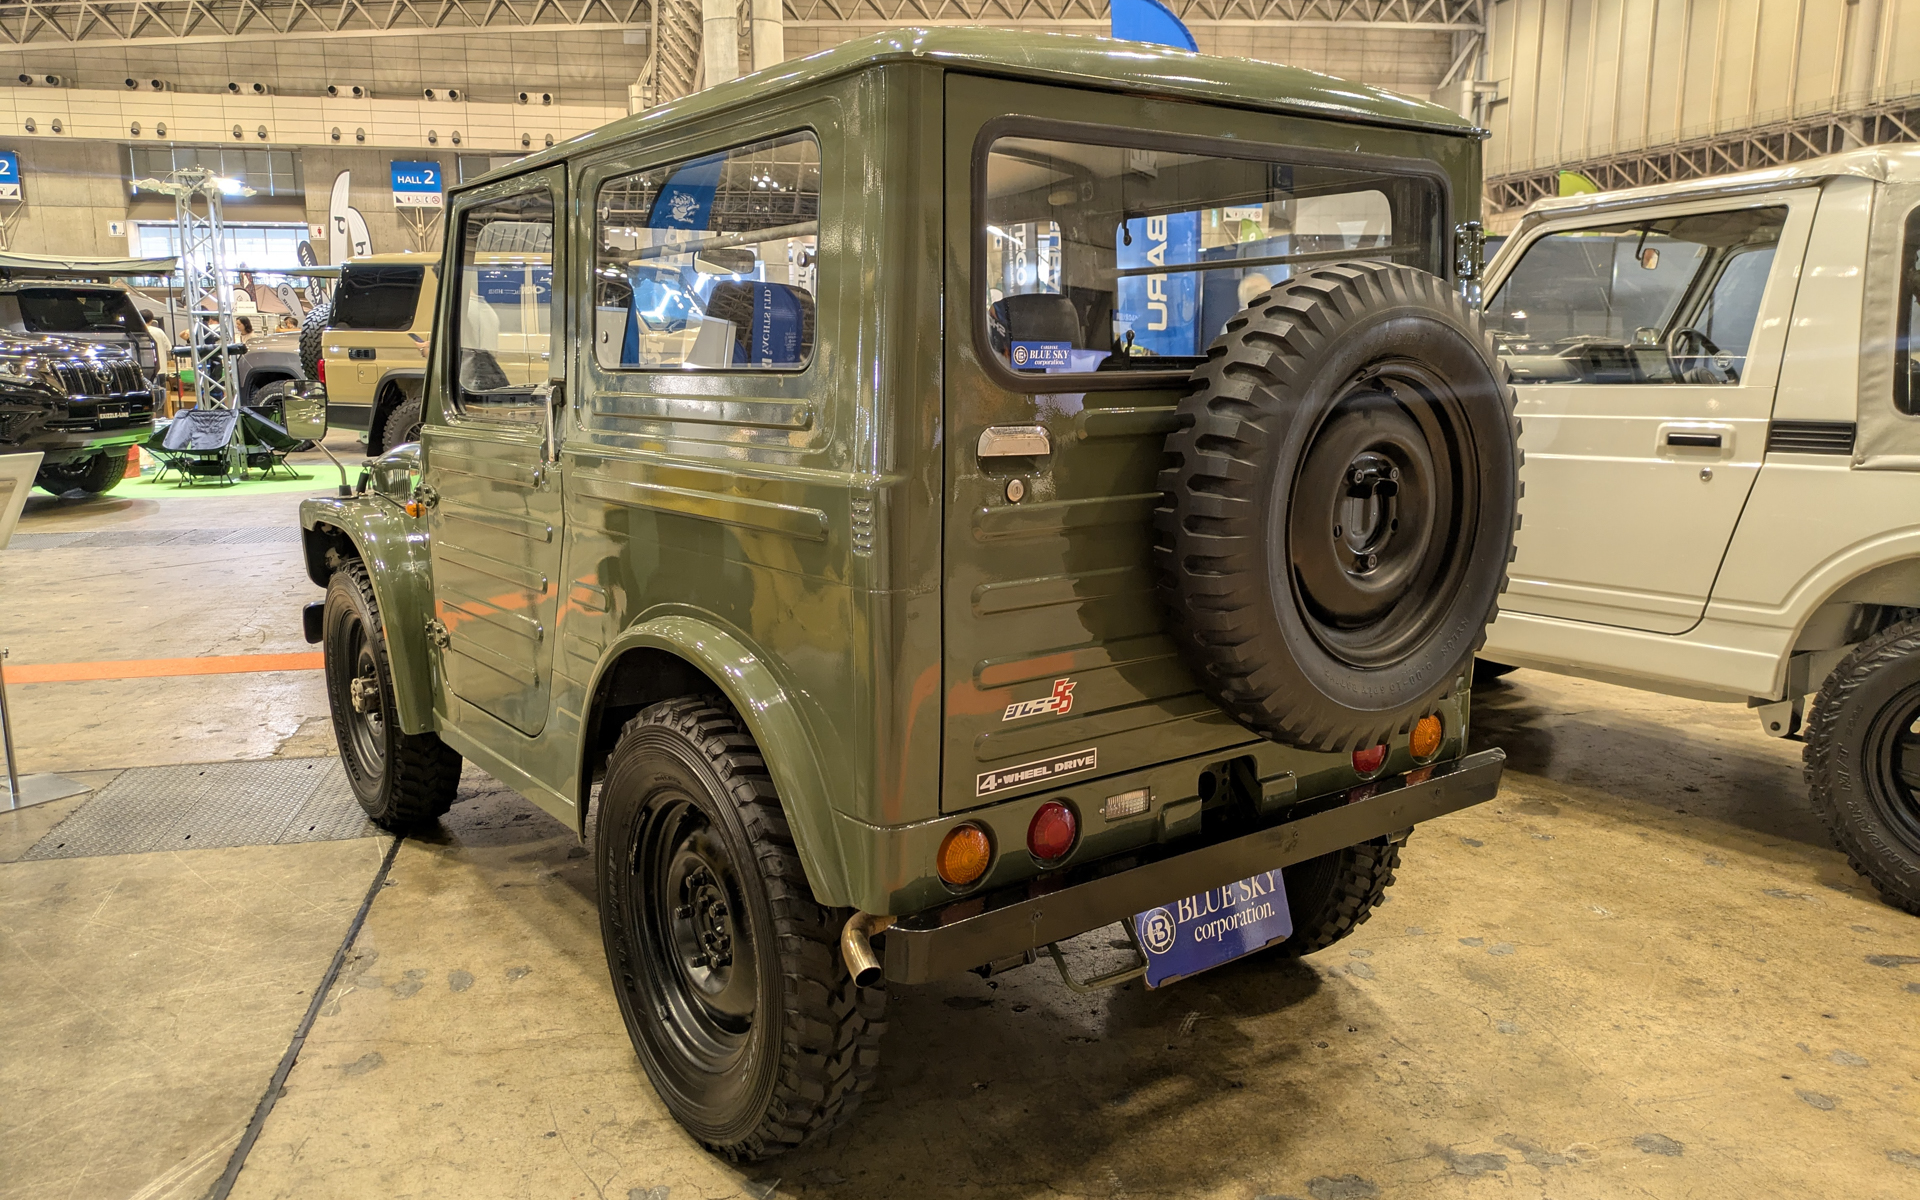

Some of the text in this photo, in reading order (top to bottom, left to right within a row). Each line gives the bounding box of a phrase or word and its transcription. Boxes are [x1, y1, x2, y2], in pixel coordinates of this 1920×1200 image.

[0, 159, 10, 175] 2
[397, 169, 435, 185] HALL 2
[1029, 350, 1069, 360] BLUE SKY
[1054, 755, 1095, 773] DRIVE
[1177, 870, 1278, 925] BLUE SKY
[1194, 901, 1276, 942] corporation.
